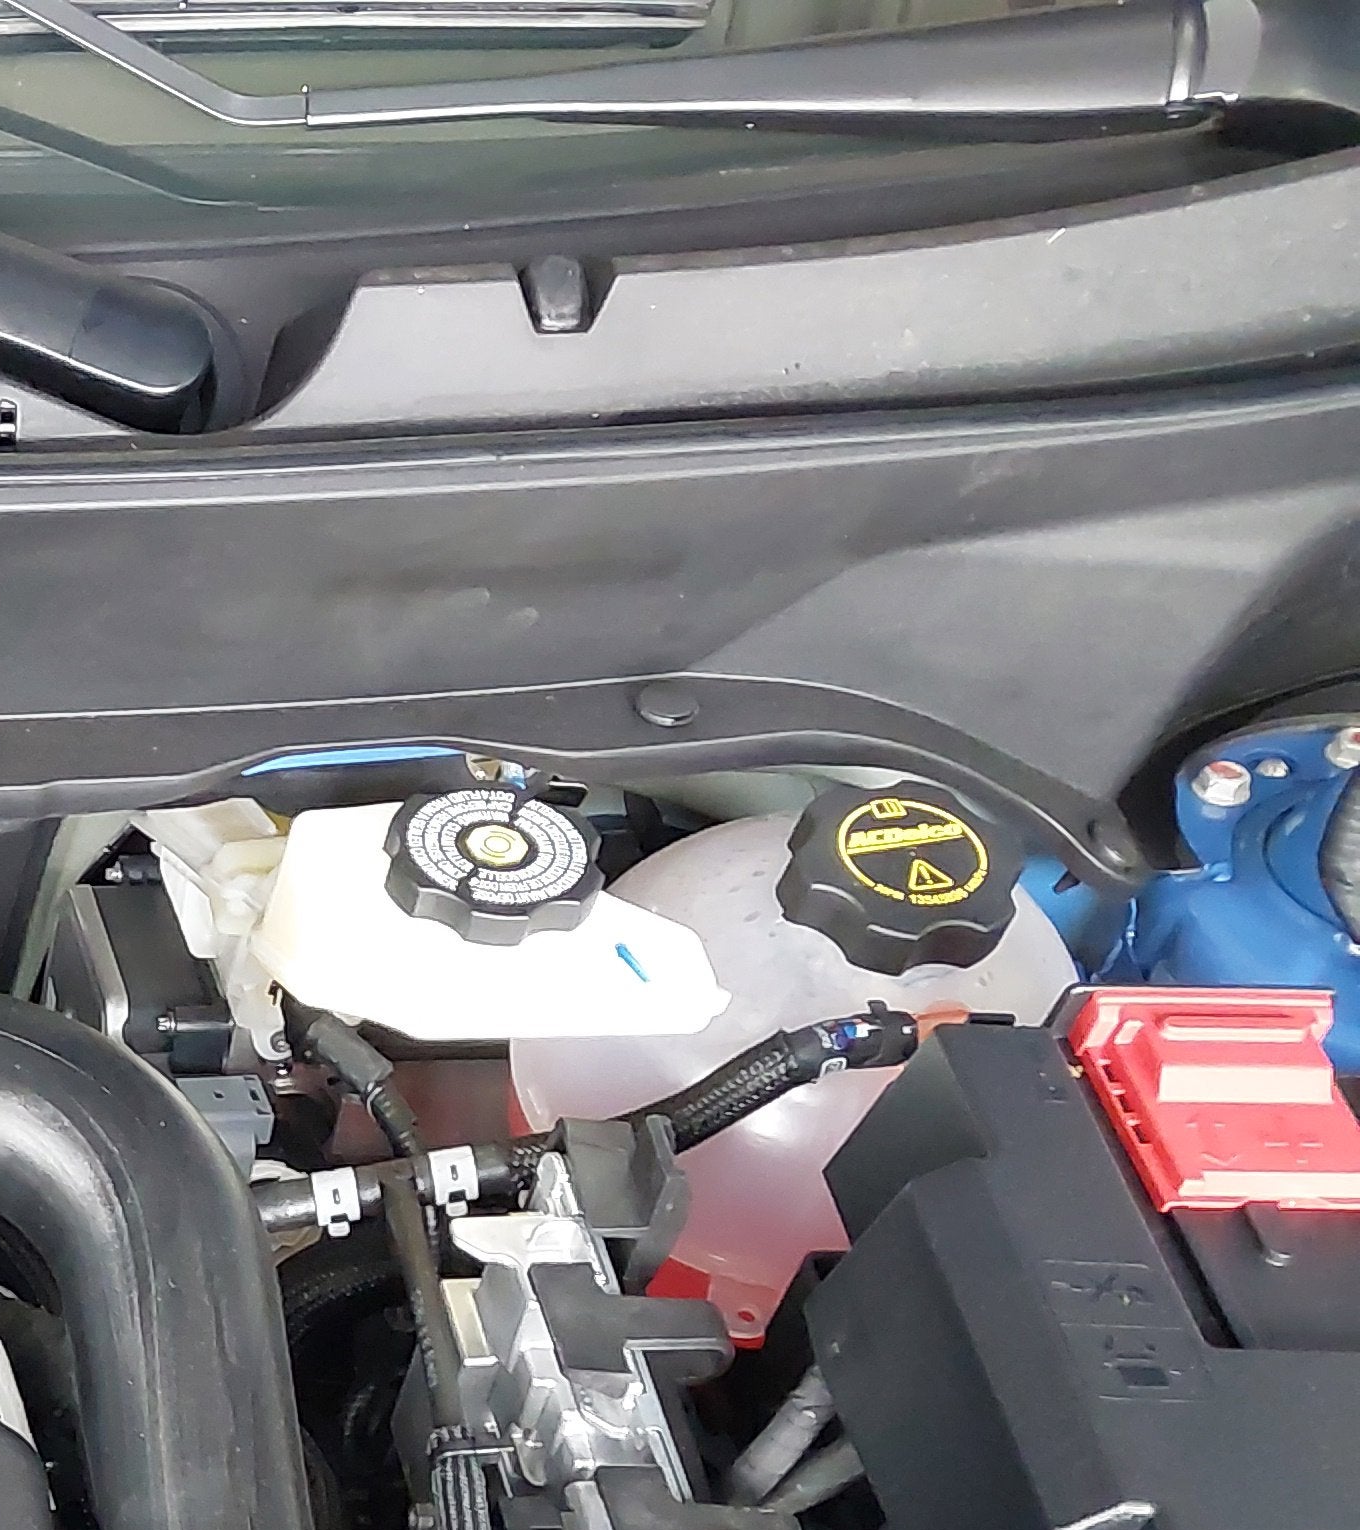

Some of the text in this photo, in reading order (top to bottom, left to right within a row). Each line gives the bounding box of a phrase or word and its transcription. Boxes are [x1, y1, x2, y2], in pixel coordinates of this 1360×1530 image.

[446, 789, 481, 804] FLUID
[488, 790, 516, 803] DOT
[847, 823, 964, 848] ACDelco
